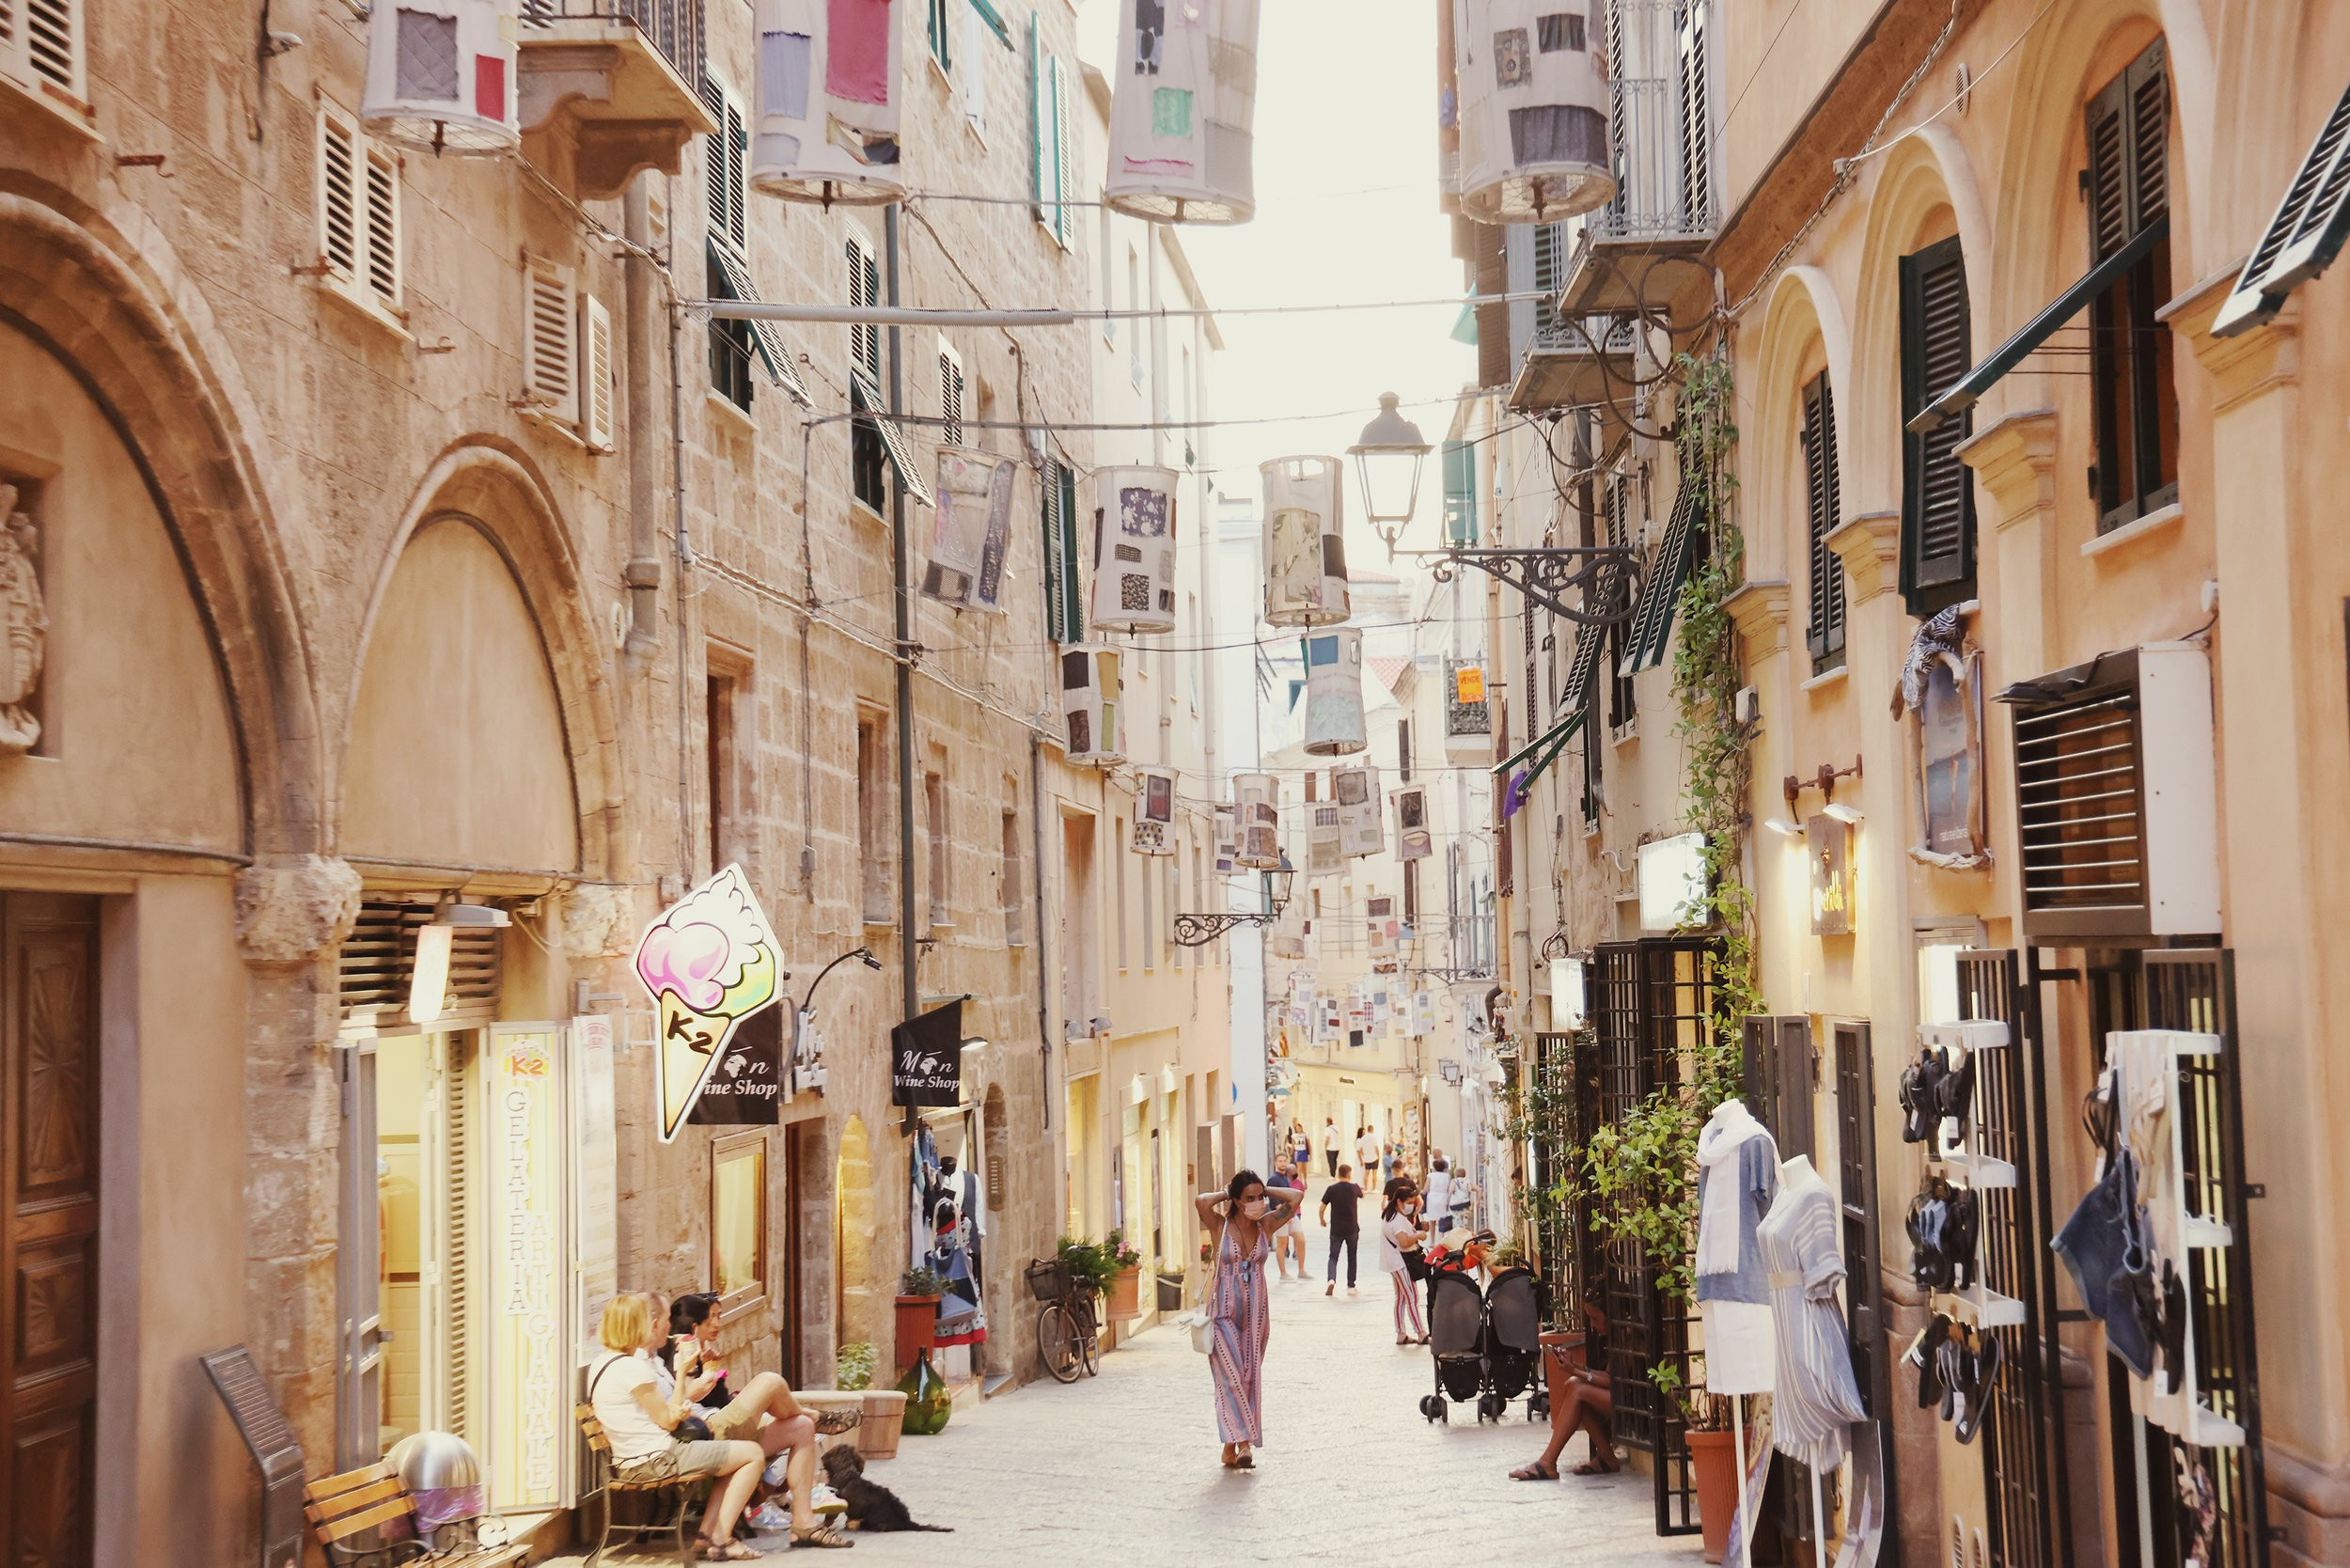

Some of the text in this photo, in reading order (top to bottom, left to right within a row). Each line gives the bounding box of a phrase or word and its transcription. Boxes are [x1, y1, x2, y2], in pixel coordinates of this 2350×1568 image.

[1459, 675, 1480, 684] VENDE
[666, 1010, 713, 1055] K2
[511, 1055, 543, 1077] K2
[704, 1079, 778, 1100] ine Shop
[894, 1074, 960, 1092] Wine Shop
[506, 1090, 526, 1310] GELATERIA
[529, 1215, 550, 1485] ARTIGIANALE
